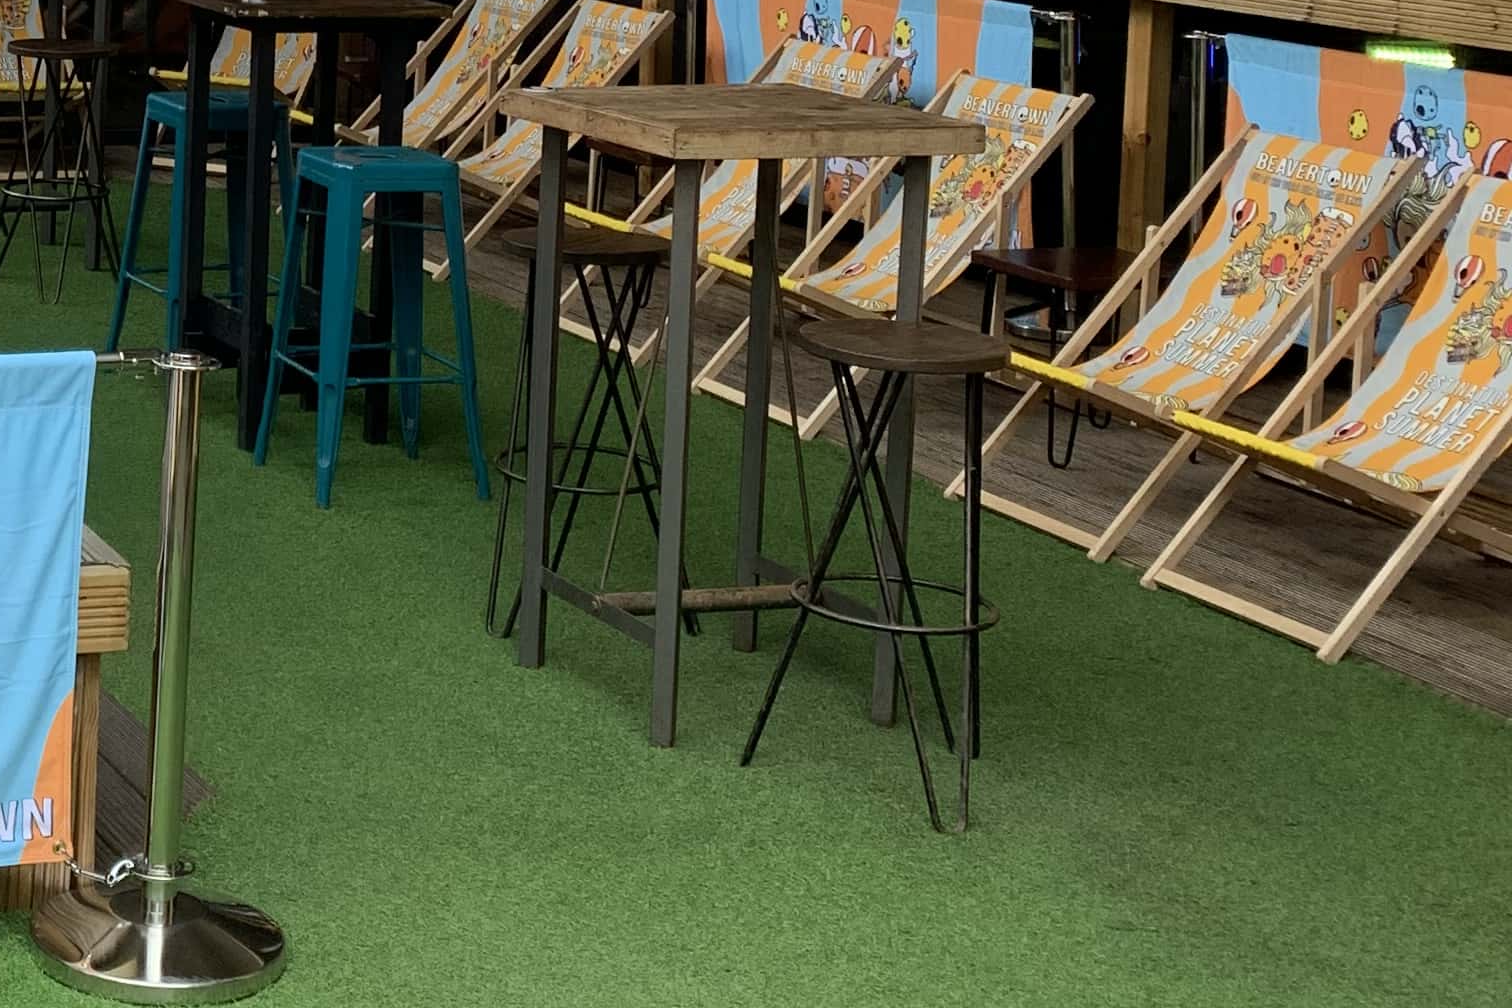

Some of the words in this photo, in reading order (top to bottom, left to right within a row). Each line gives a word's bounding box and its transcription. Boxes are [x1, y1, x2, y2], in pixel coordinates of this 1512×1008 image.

[791, 57, 866, 85] BEAVERTOWN
[963, 95, 1053, 126] BEAVERTOWN
[1255, 152, 1373, 193] BEAVERTOWN
[1155, 339, 1240, 378] SUMMER
[1173, 318, 1259, 360] PLANET
[1415, 370, 1510, 407] DESTINATION
[1393, 386, 1500, 433] PLANET
[1372, 411, 1475, 453] SUMMER
